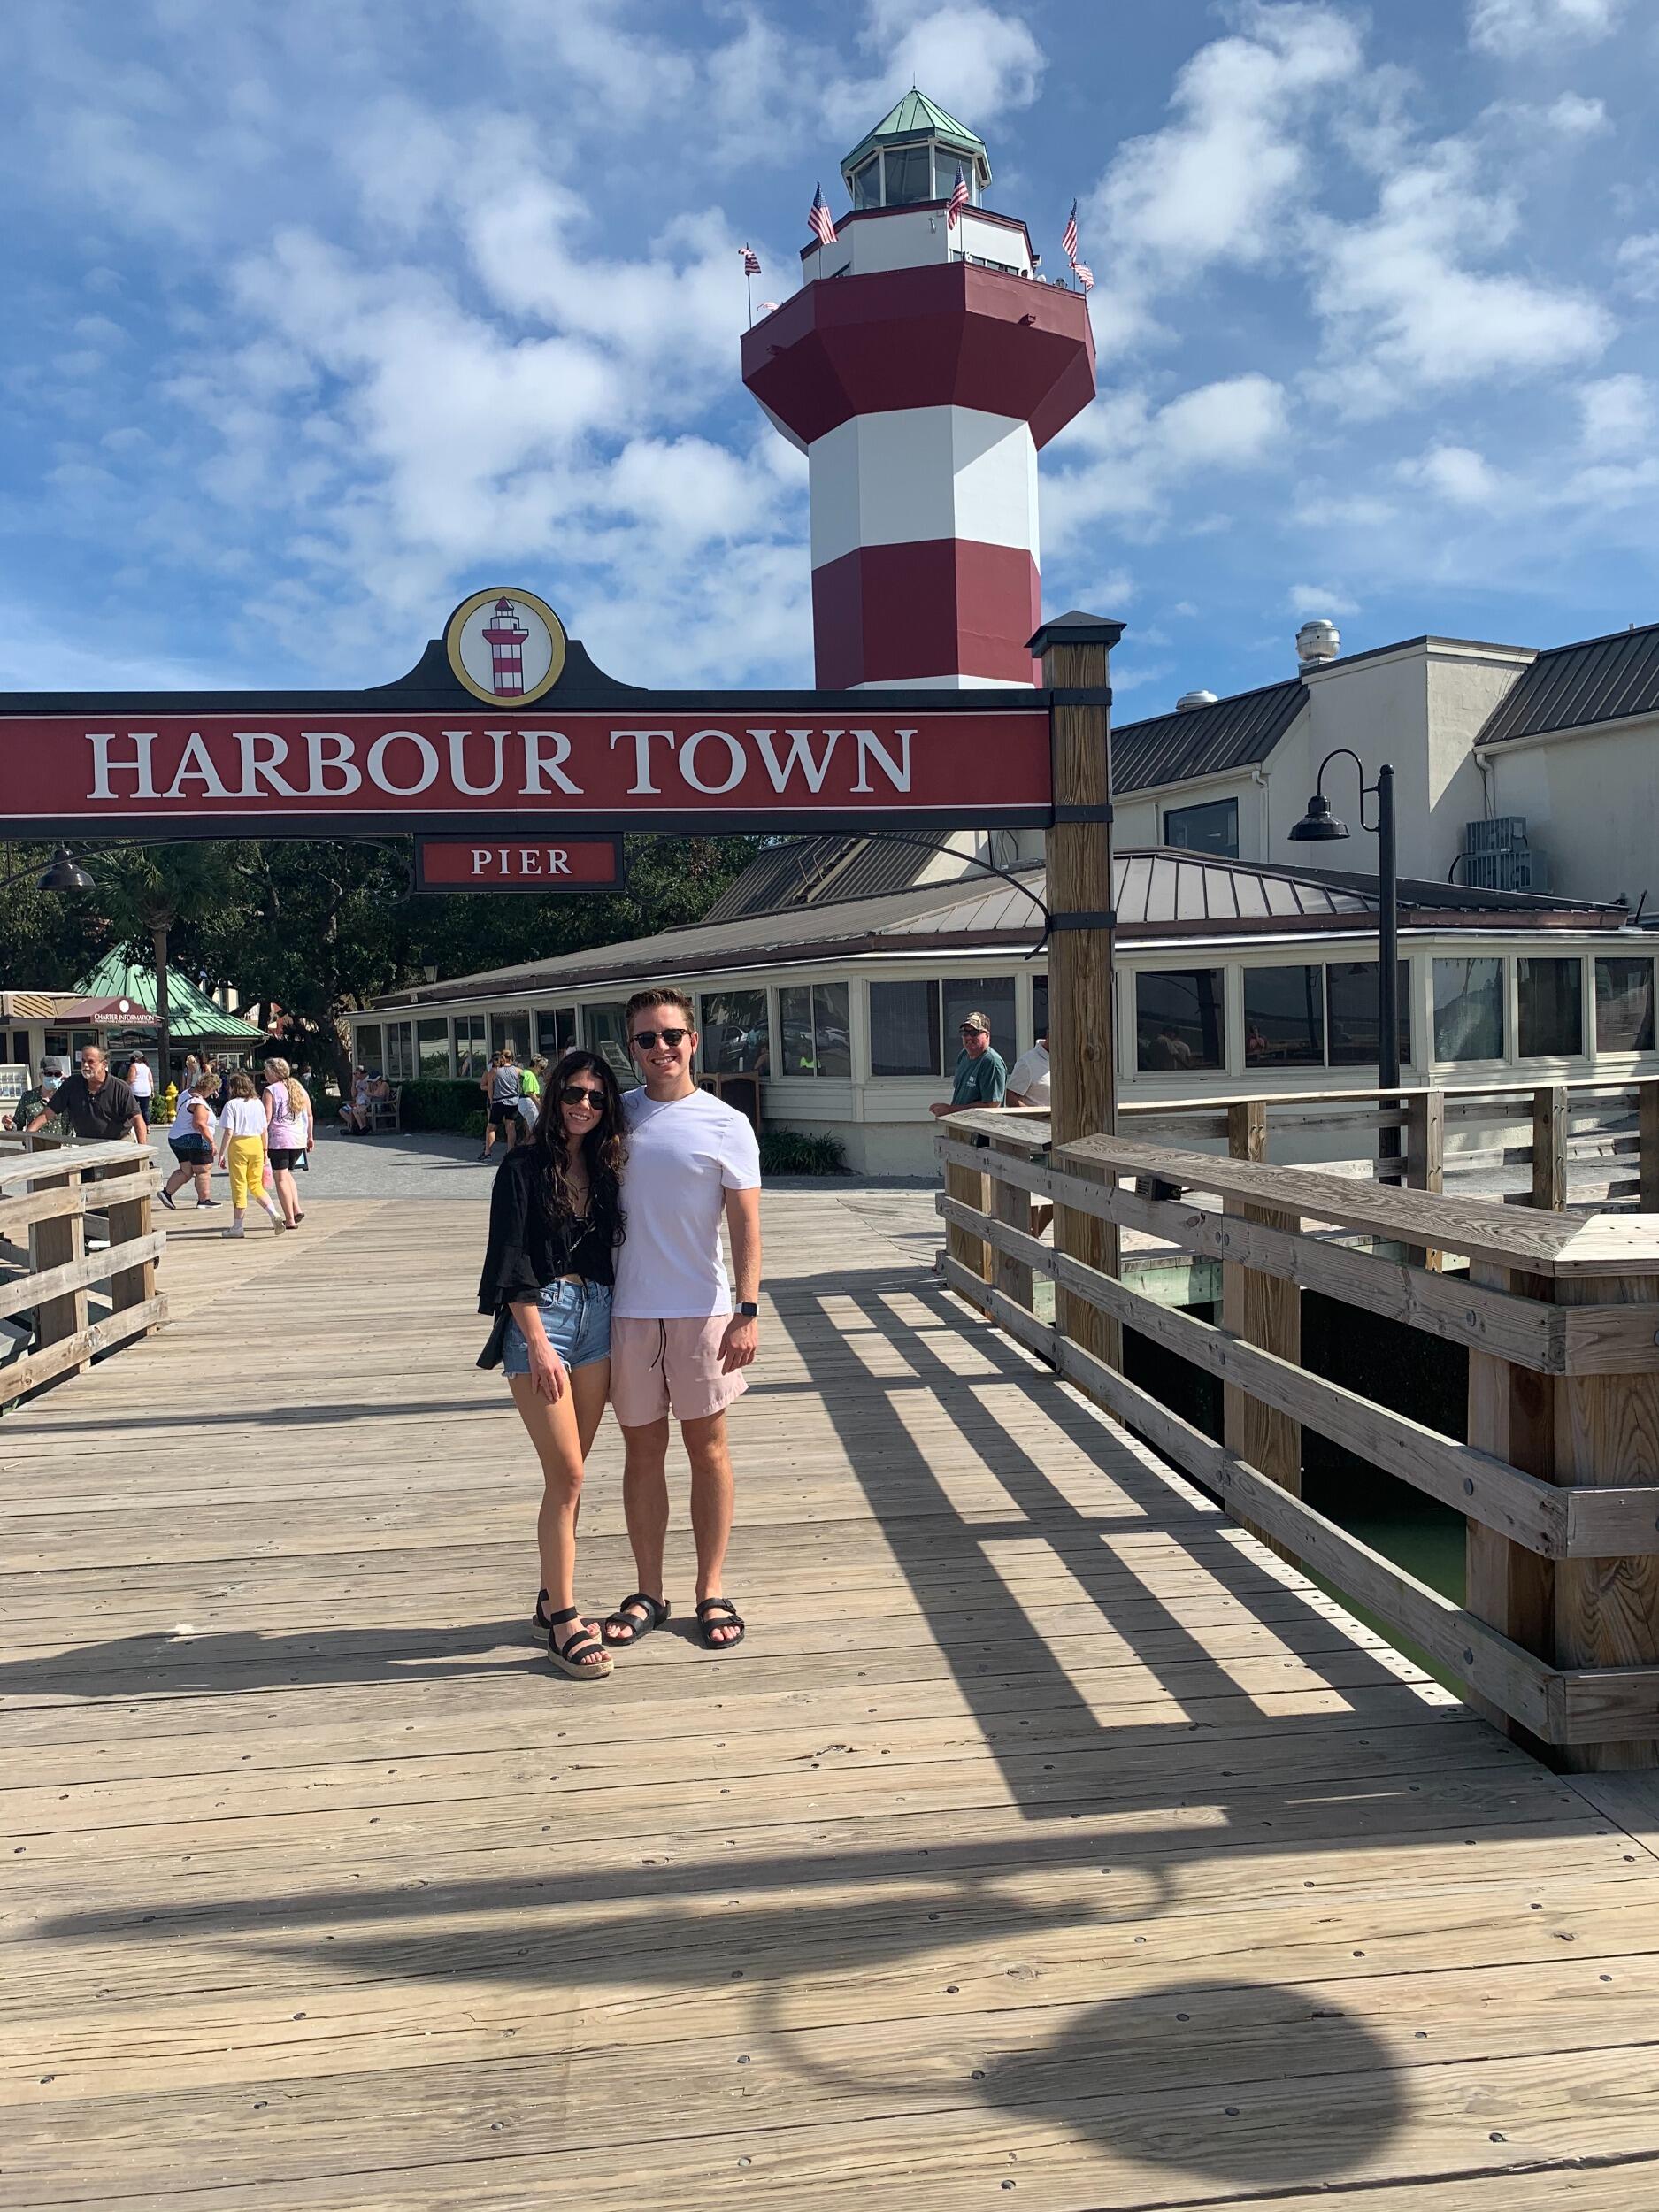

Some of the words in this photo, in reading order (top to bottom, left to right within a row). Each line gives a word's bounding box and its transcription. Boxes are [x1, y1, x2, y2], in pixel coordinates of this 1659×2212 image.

[85, 731, 584, 799] HARBOUR
[610, 729, 918, 795] TOWN
[471, 849, 573, 874] PIER
